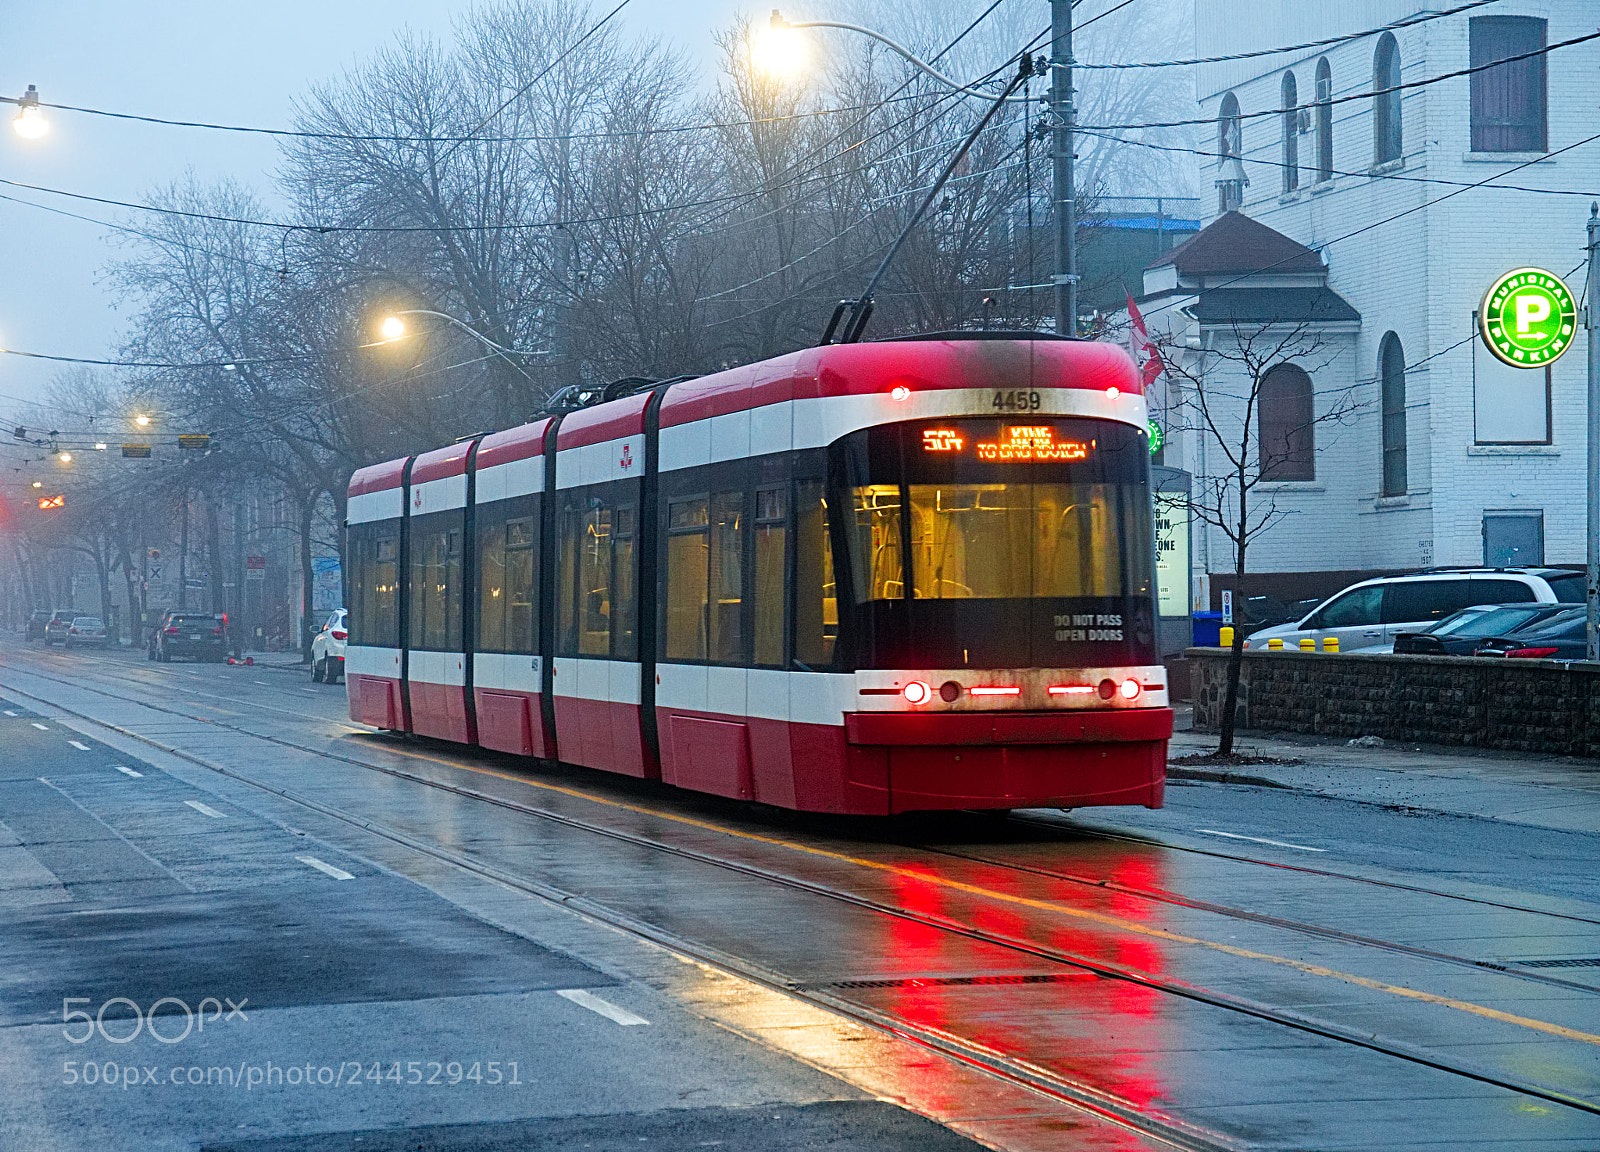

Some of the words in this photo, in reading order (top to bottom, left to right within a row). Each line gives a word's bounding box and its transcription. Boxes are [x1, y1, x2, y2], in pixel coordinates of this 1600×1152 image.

[1491, 275, 1569, 310] MUNICIPAL
[1516, 295, 1551, 332] P
[1491, 324, 1572, 361] PARKING
[992, 391, 1041, 410] 4459
[1054, 615, 1070, 627] DO
[1072, 614, 1095, 626] NOT
[1096, 614, 1123, 626] PASS
[1055, 629, 1086, 641] OPEN
[1088, 629, 1124, 641] DOORS
